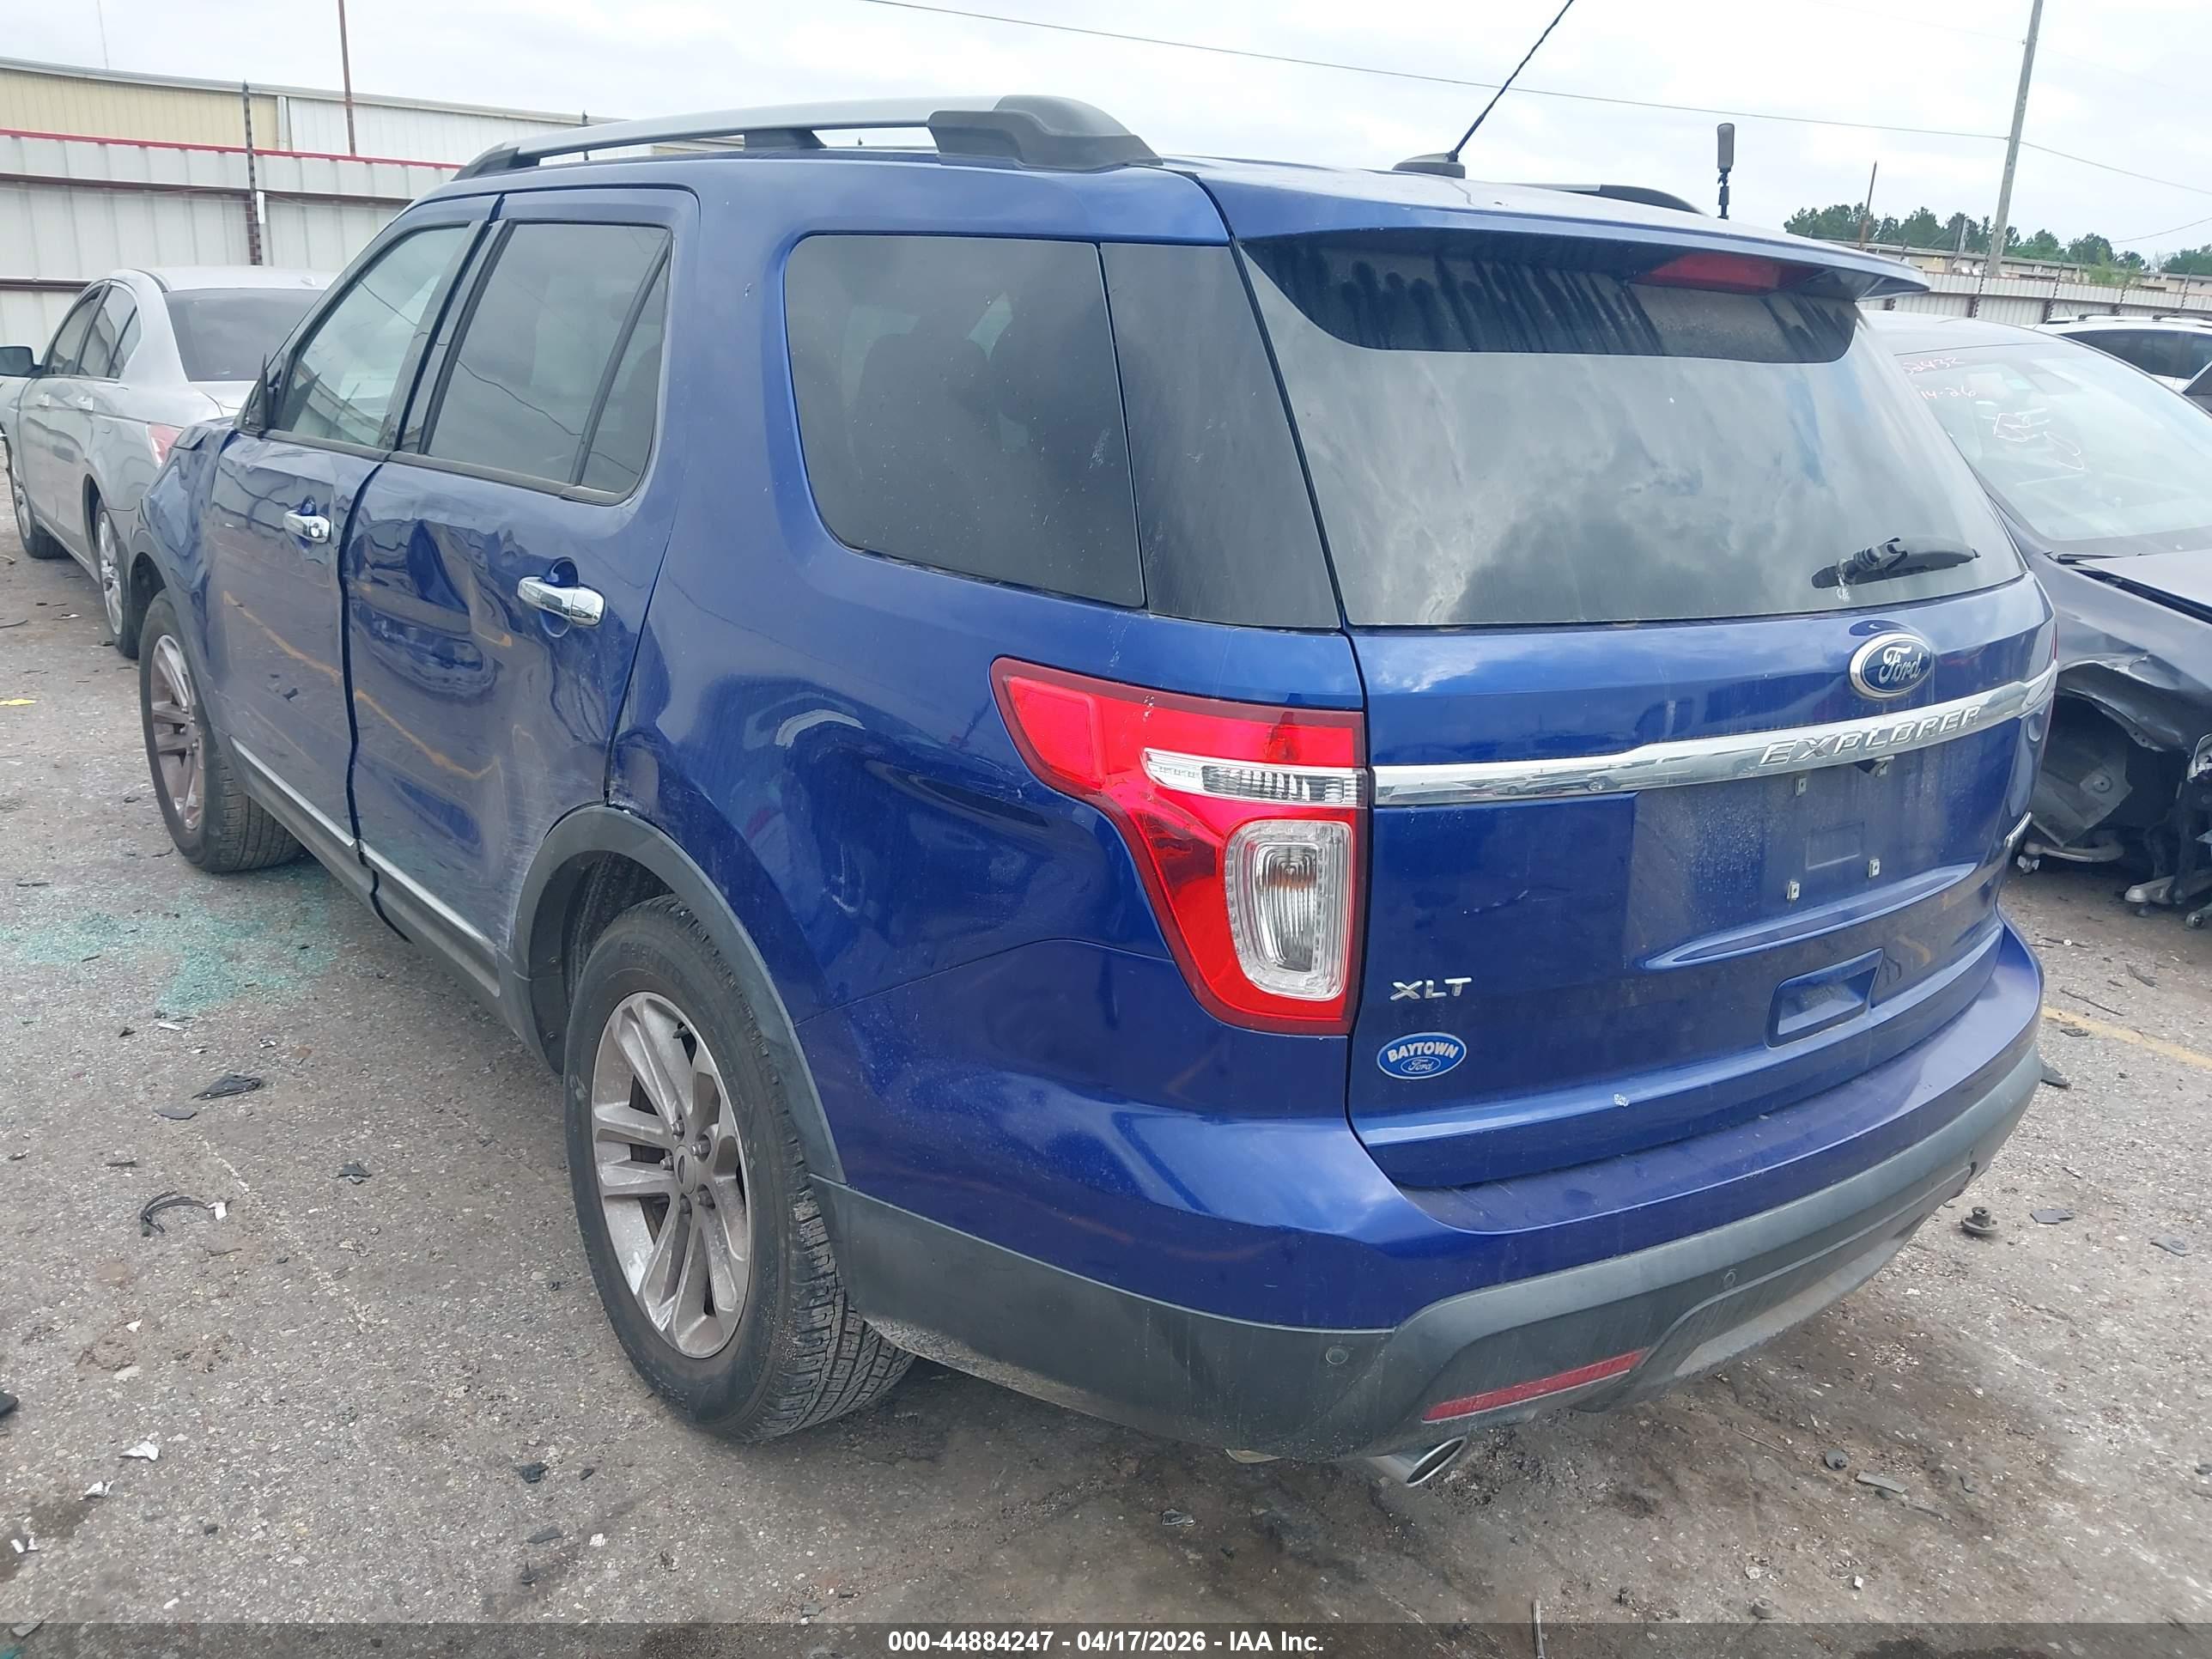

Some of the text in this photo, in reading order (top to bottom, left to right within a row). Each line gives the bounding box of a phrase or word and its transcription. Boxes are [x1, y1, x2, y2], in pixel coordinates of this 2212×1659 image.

[1878, 645, 1923, 684] Ford
[1758, 704, 1982, 767] EXPLORER
[1389, 976, 1473, 1000] XLT
[1387, 1041, 1460, 1063] BAYTOWN
[1407, 1059, 1435, 1072] Ford
